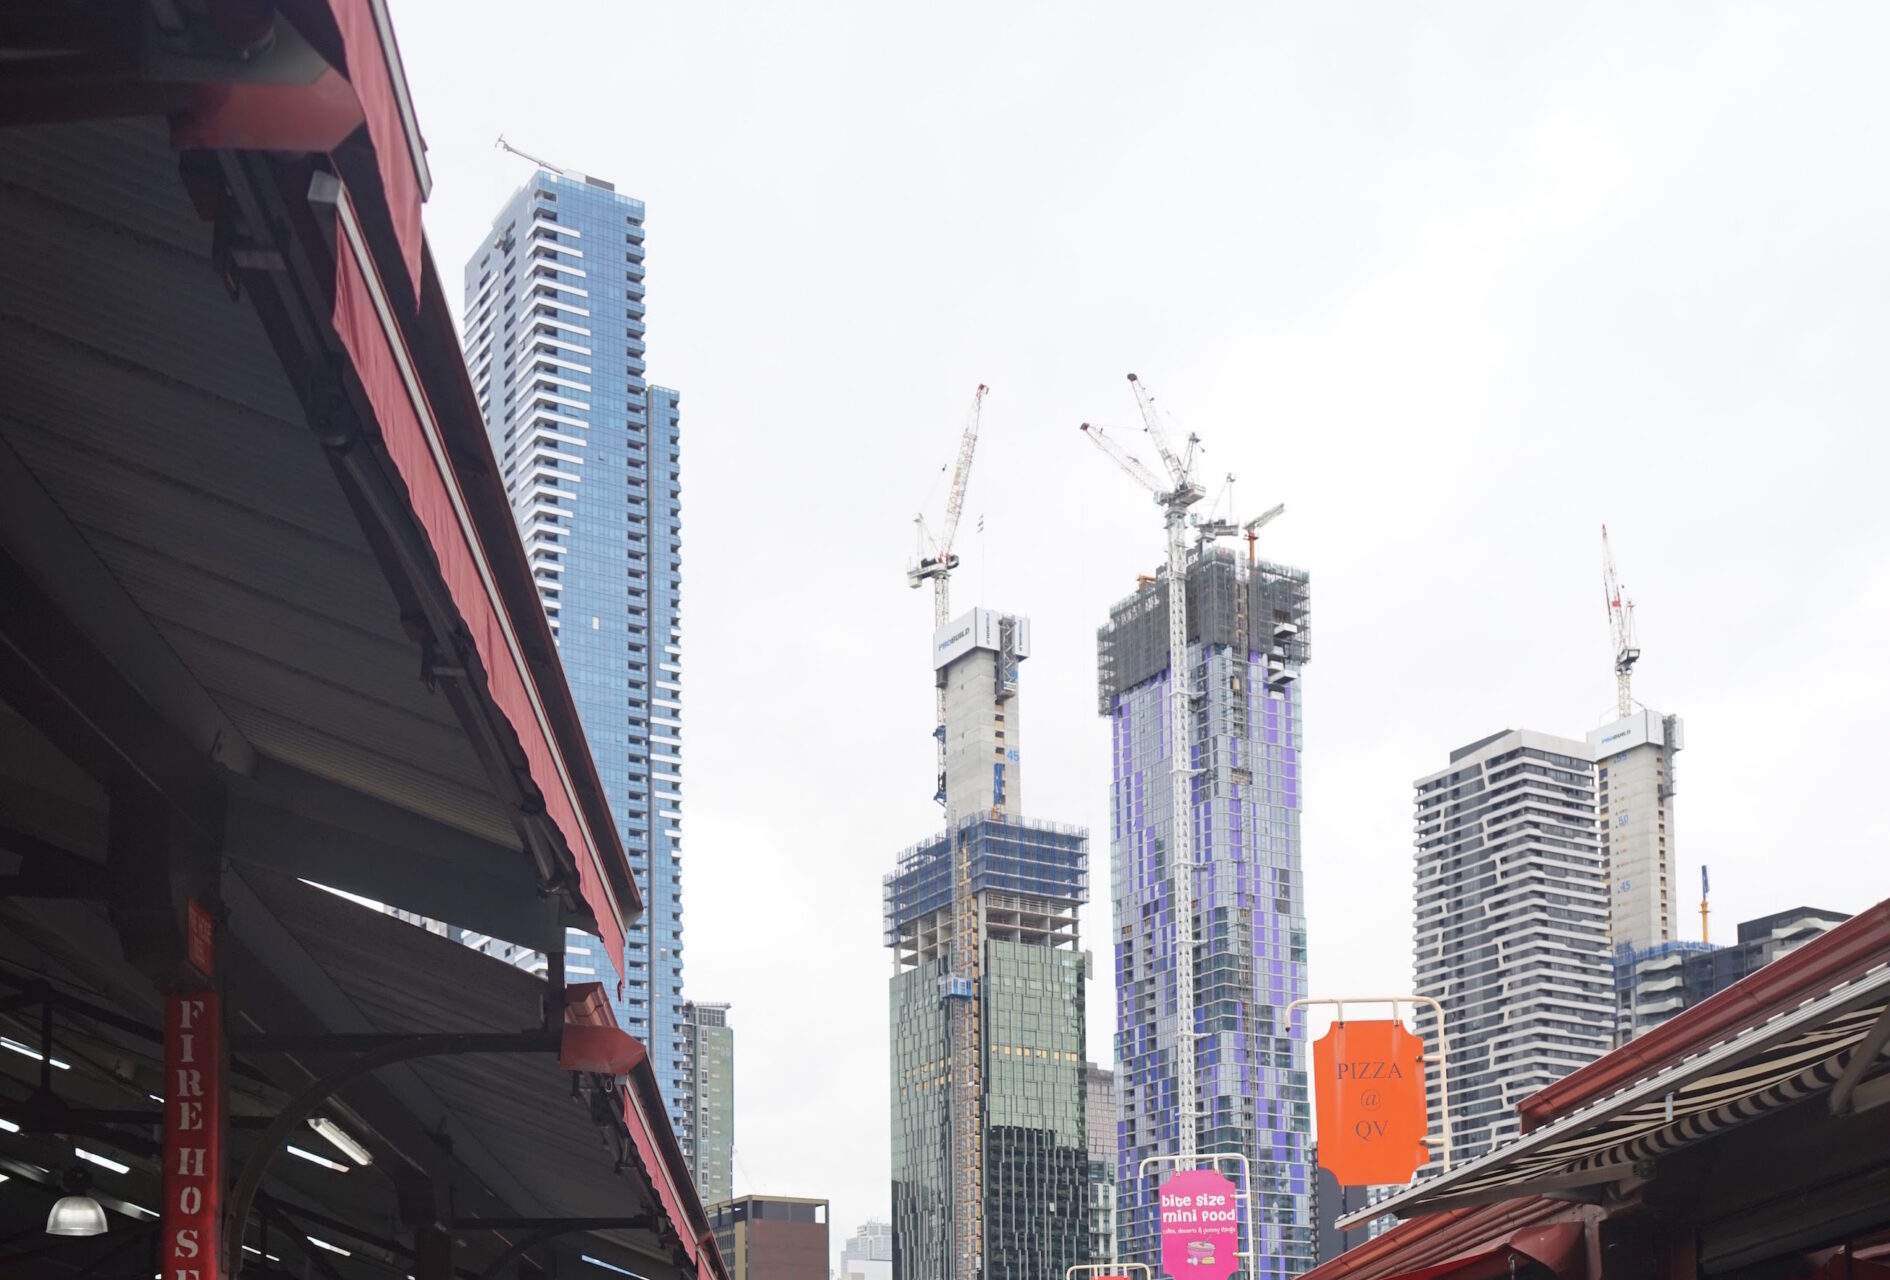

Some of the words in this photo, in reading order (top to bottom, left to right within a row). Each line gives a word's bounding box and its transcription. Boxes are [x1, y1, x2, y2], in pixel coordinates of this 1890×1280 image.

[176, 1000, 204, 1130] FIRE
[1337, 1061, 1403, 1080] PIZZA
[1360, 1089, 1382, 1111] @
[1355, 1120, 1389, 1142] QV
[1162, 1194, 1192, 1207] bite
[1196, 1193, 1226, 1207] size
[1163, 1209, 1197, 1223] mini
[1202, 1208, 1236, 1221] food
